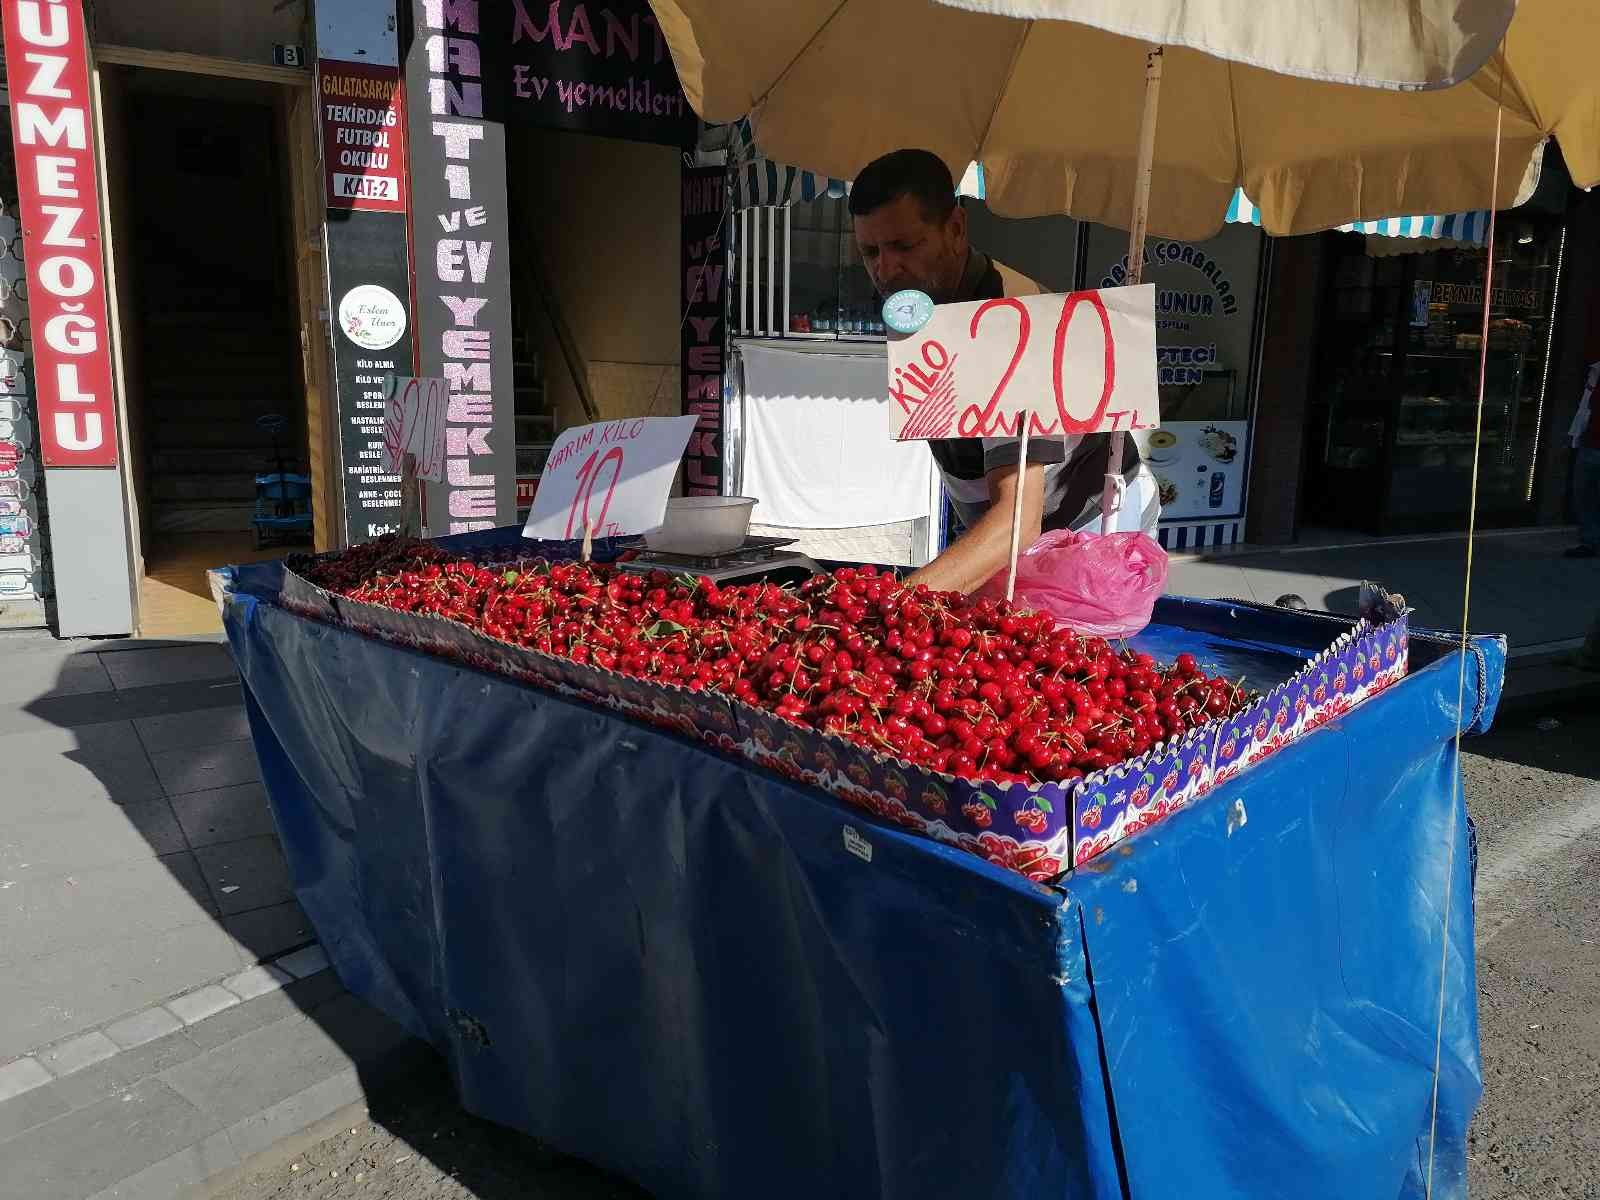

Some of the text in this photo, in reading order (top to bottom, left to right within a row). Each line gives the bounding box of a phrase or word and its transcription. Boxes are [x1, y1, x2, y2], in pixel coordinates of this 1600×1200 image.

[322, 75, 396, 101] GALATASARAY
[512, 64, 551, 101] Ev
[326, 103, 397, 127] TEKİRDAĞ
[336, 127, 390, 149] FUTBOL
[340, 150, 389, 169] OKULU
[342, 175, 390, 198] KAT:2
[438, 206, 488, 233] VE
[436, 239, 493, 284] EV
[1155, 290, 1216, 316] UNUR
[356, 359, 395, 369] KİLO ALMA
[957, 289, 1116, 437] 20
[355, 374, 372, 384] KİLO
[888, 340, 948, 415] KİLO
[1158, 367, 1204, 386] REN
[563, 446, 624, 541] 10
